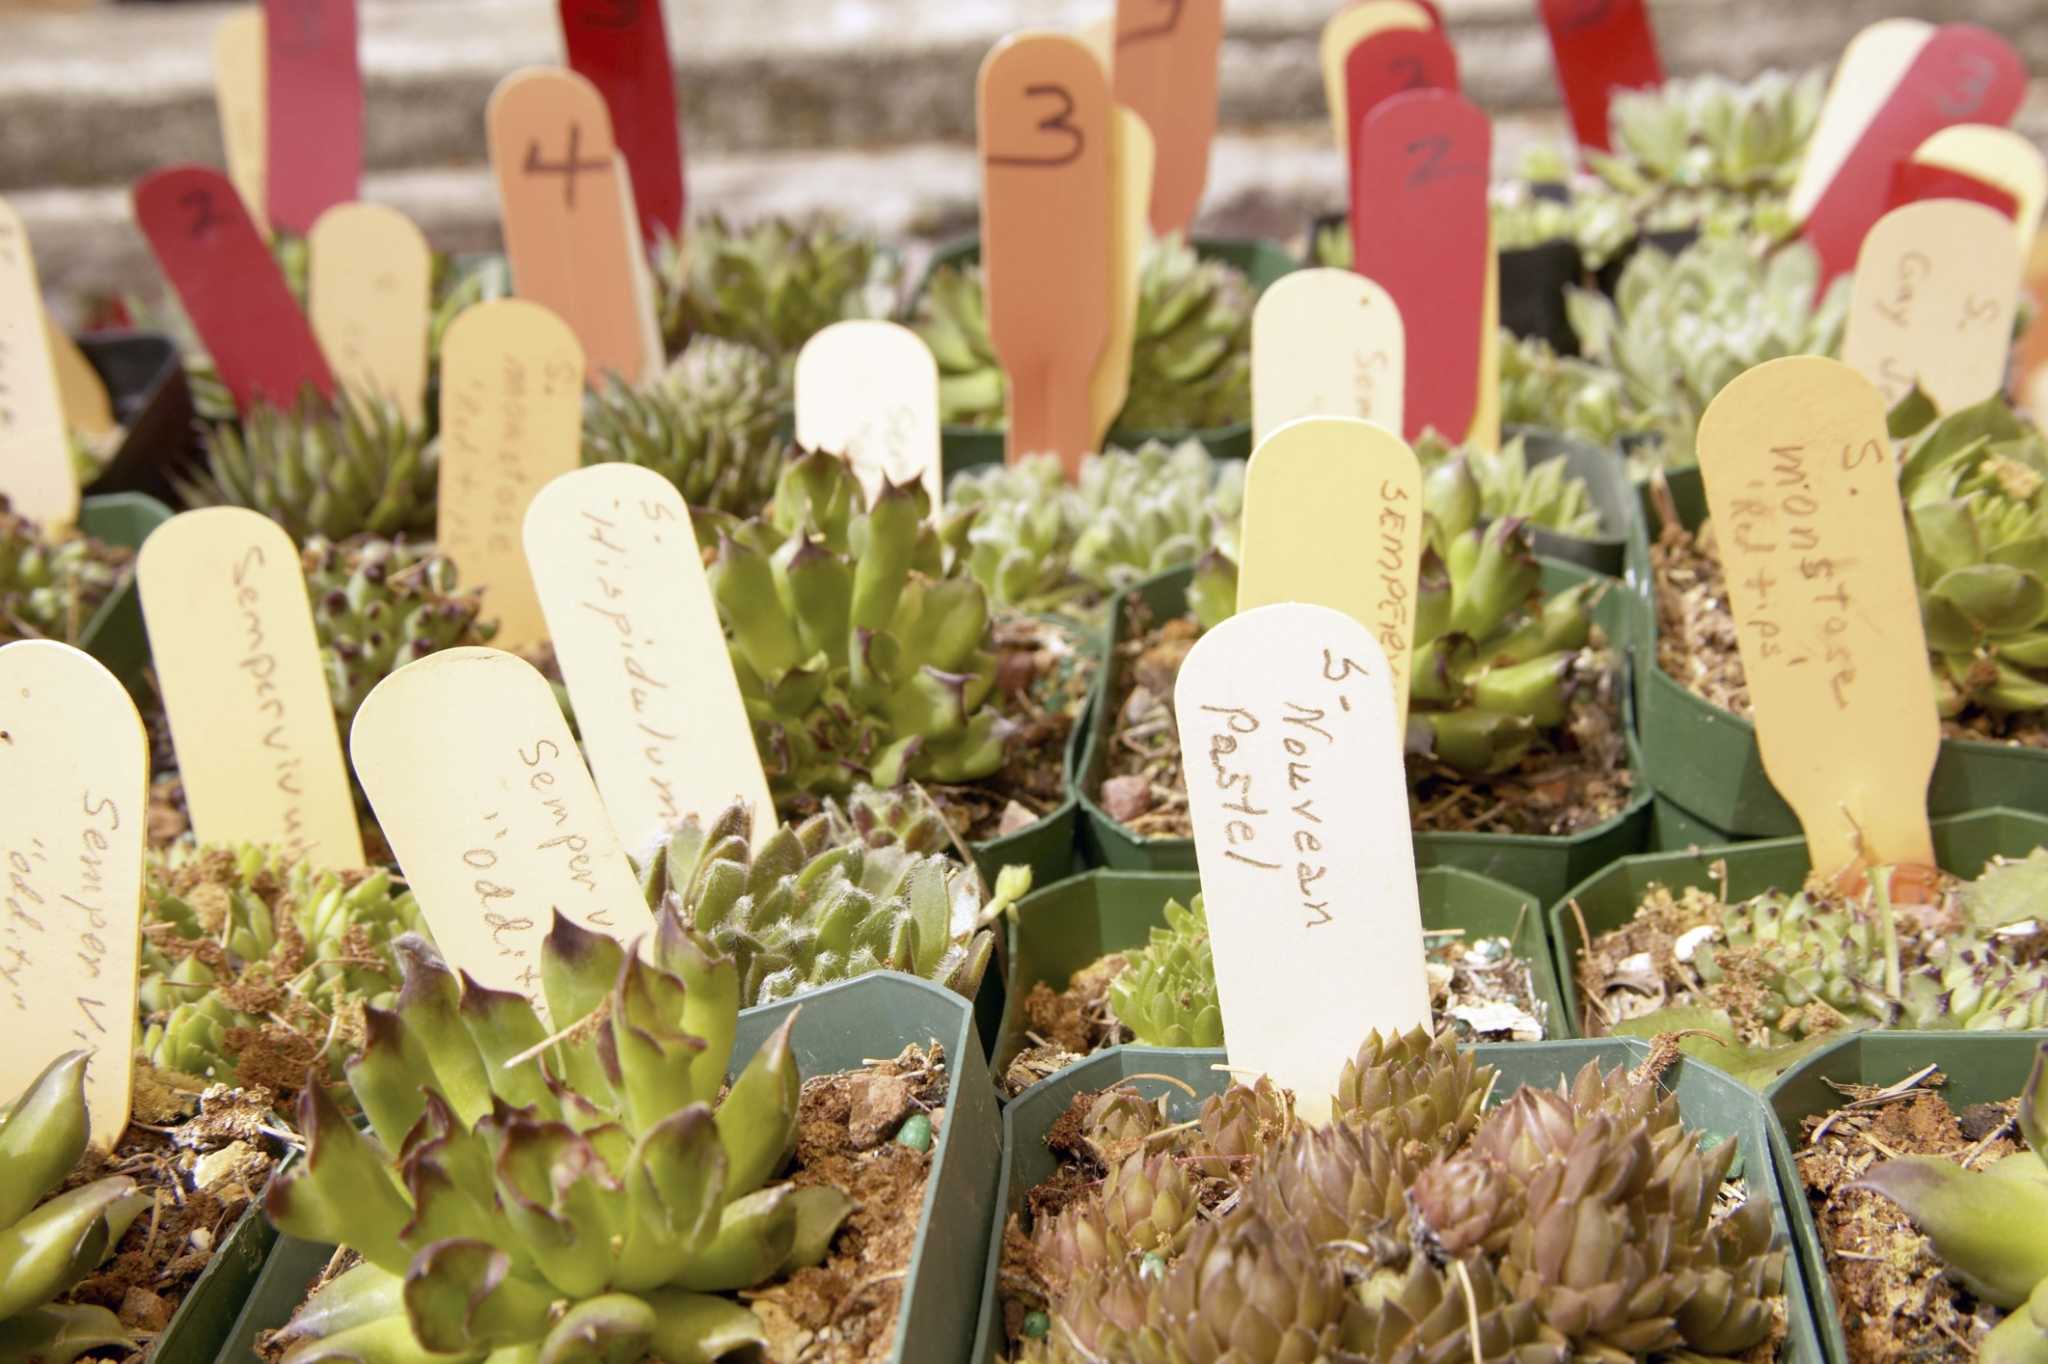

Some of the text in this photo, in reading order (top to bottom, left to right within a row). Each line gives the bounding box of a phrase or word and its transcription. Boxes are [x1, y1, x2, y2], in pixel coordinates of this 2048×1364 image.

[521, 122, 611, 209] 4
[985, 84, 1084, 166] 3
[1838, 437, 1885, 499] S.
